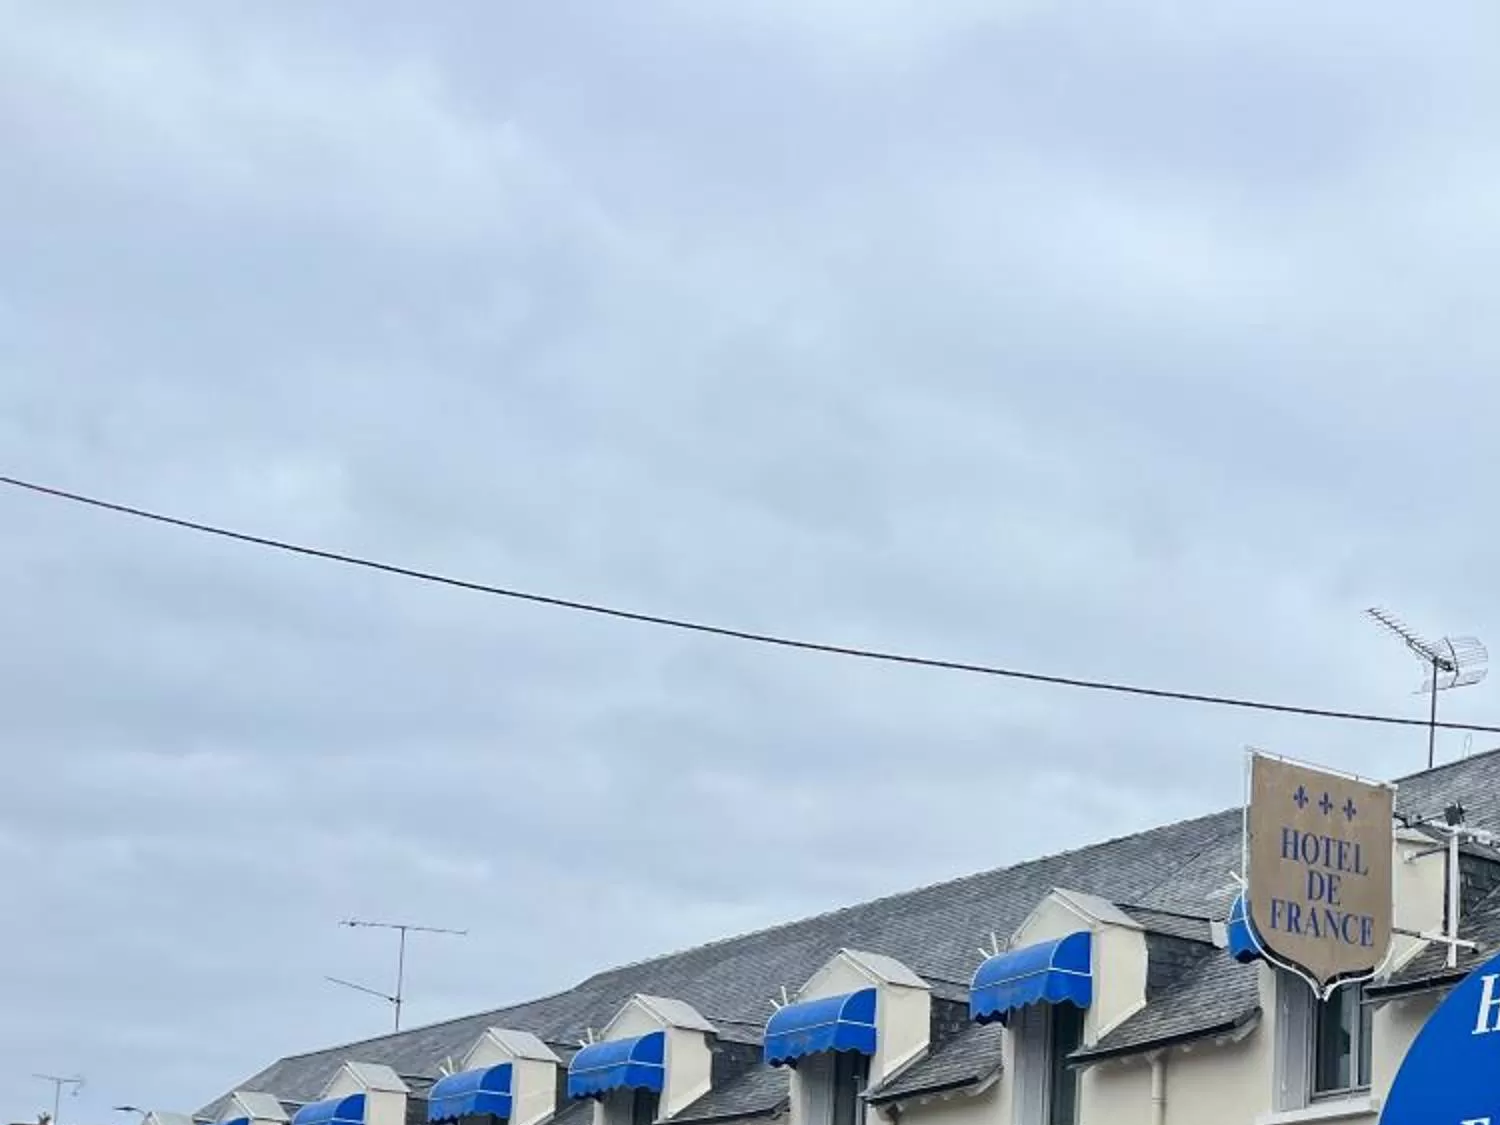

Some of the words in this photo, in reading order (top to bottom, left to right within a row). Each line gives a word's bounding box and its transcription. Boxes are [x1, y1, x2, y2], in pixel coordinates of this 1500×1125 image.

[1281, 828, 1369, 876] HOTEL
[1307, 869, 1341, 906] DE
[1270, 898, 1375, 947] FRANCE
